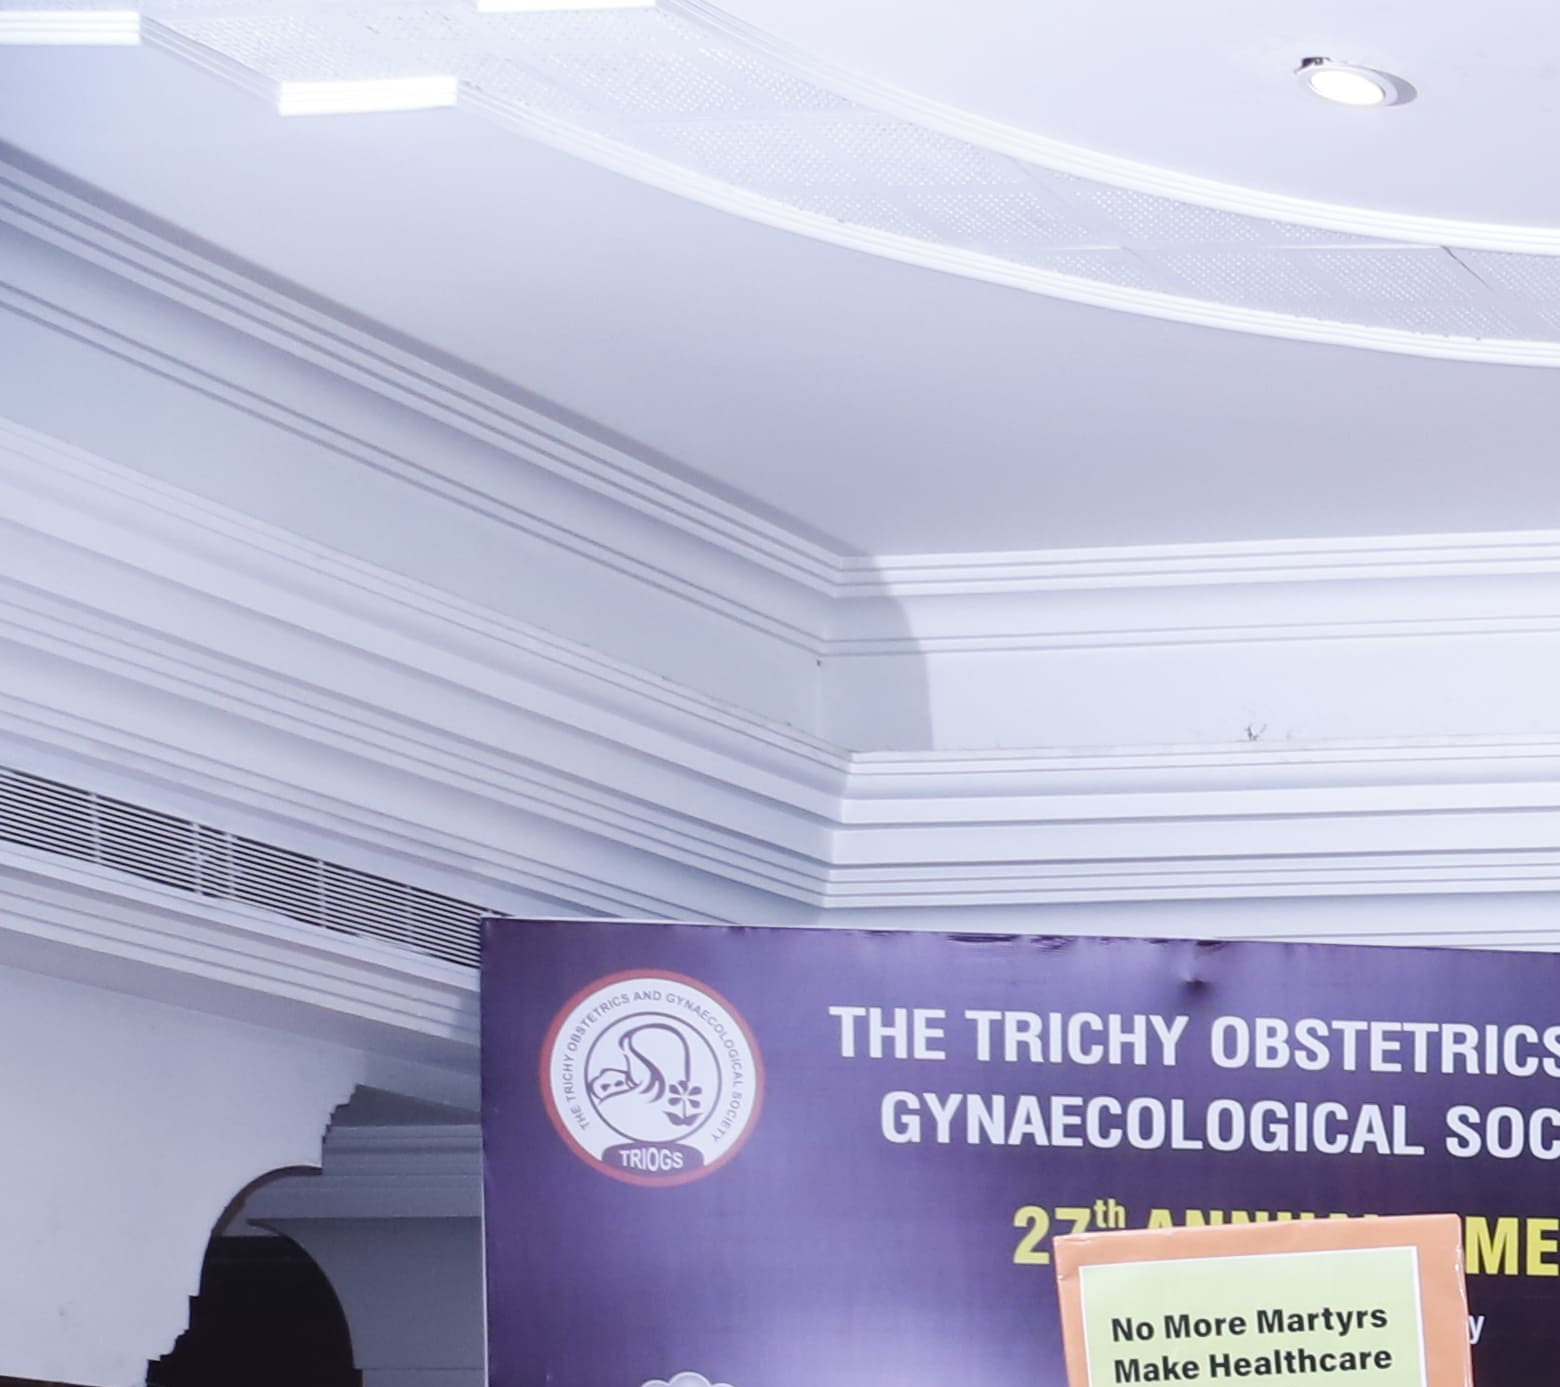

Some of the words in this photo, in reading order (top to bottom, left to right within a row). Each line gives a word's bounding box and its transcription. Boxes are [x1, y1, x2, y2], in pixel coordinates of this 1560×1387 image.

[829, 1006, 945, 1060] THE
[966, 1010, 1188, 1066] TRICHY
[880, 1091, 1424, 1157] GYNAECOLOGICAL
[1111, 1317, 1154, 1343] No
[1164, 1311, 1247, 1339] More
[1257, 1305, 1388, 1337] Martyrs
[1114, 1358, 1200, 1384] Make
[1209, 1347, 1393, 1379] Healthcare
